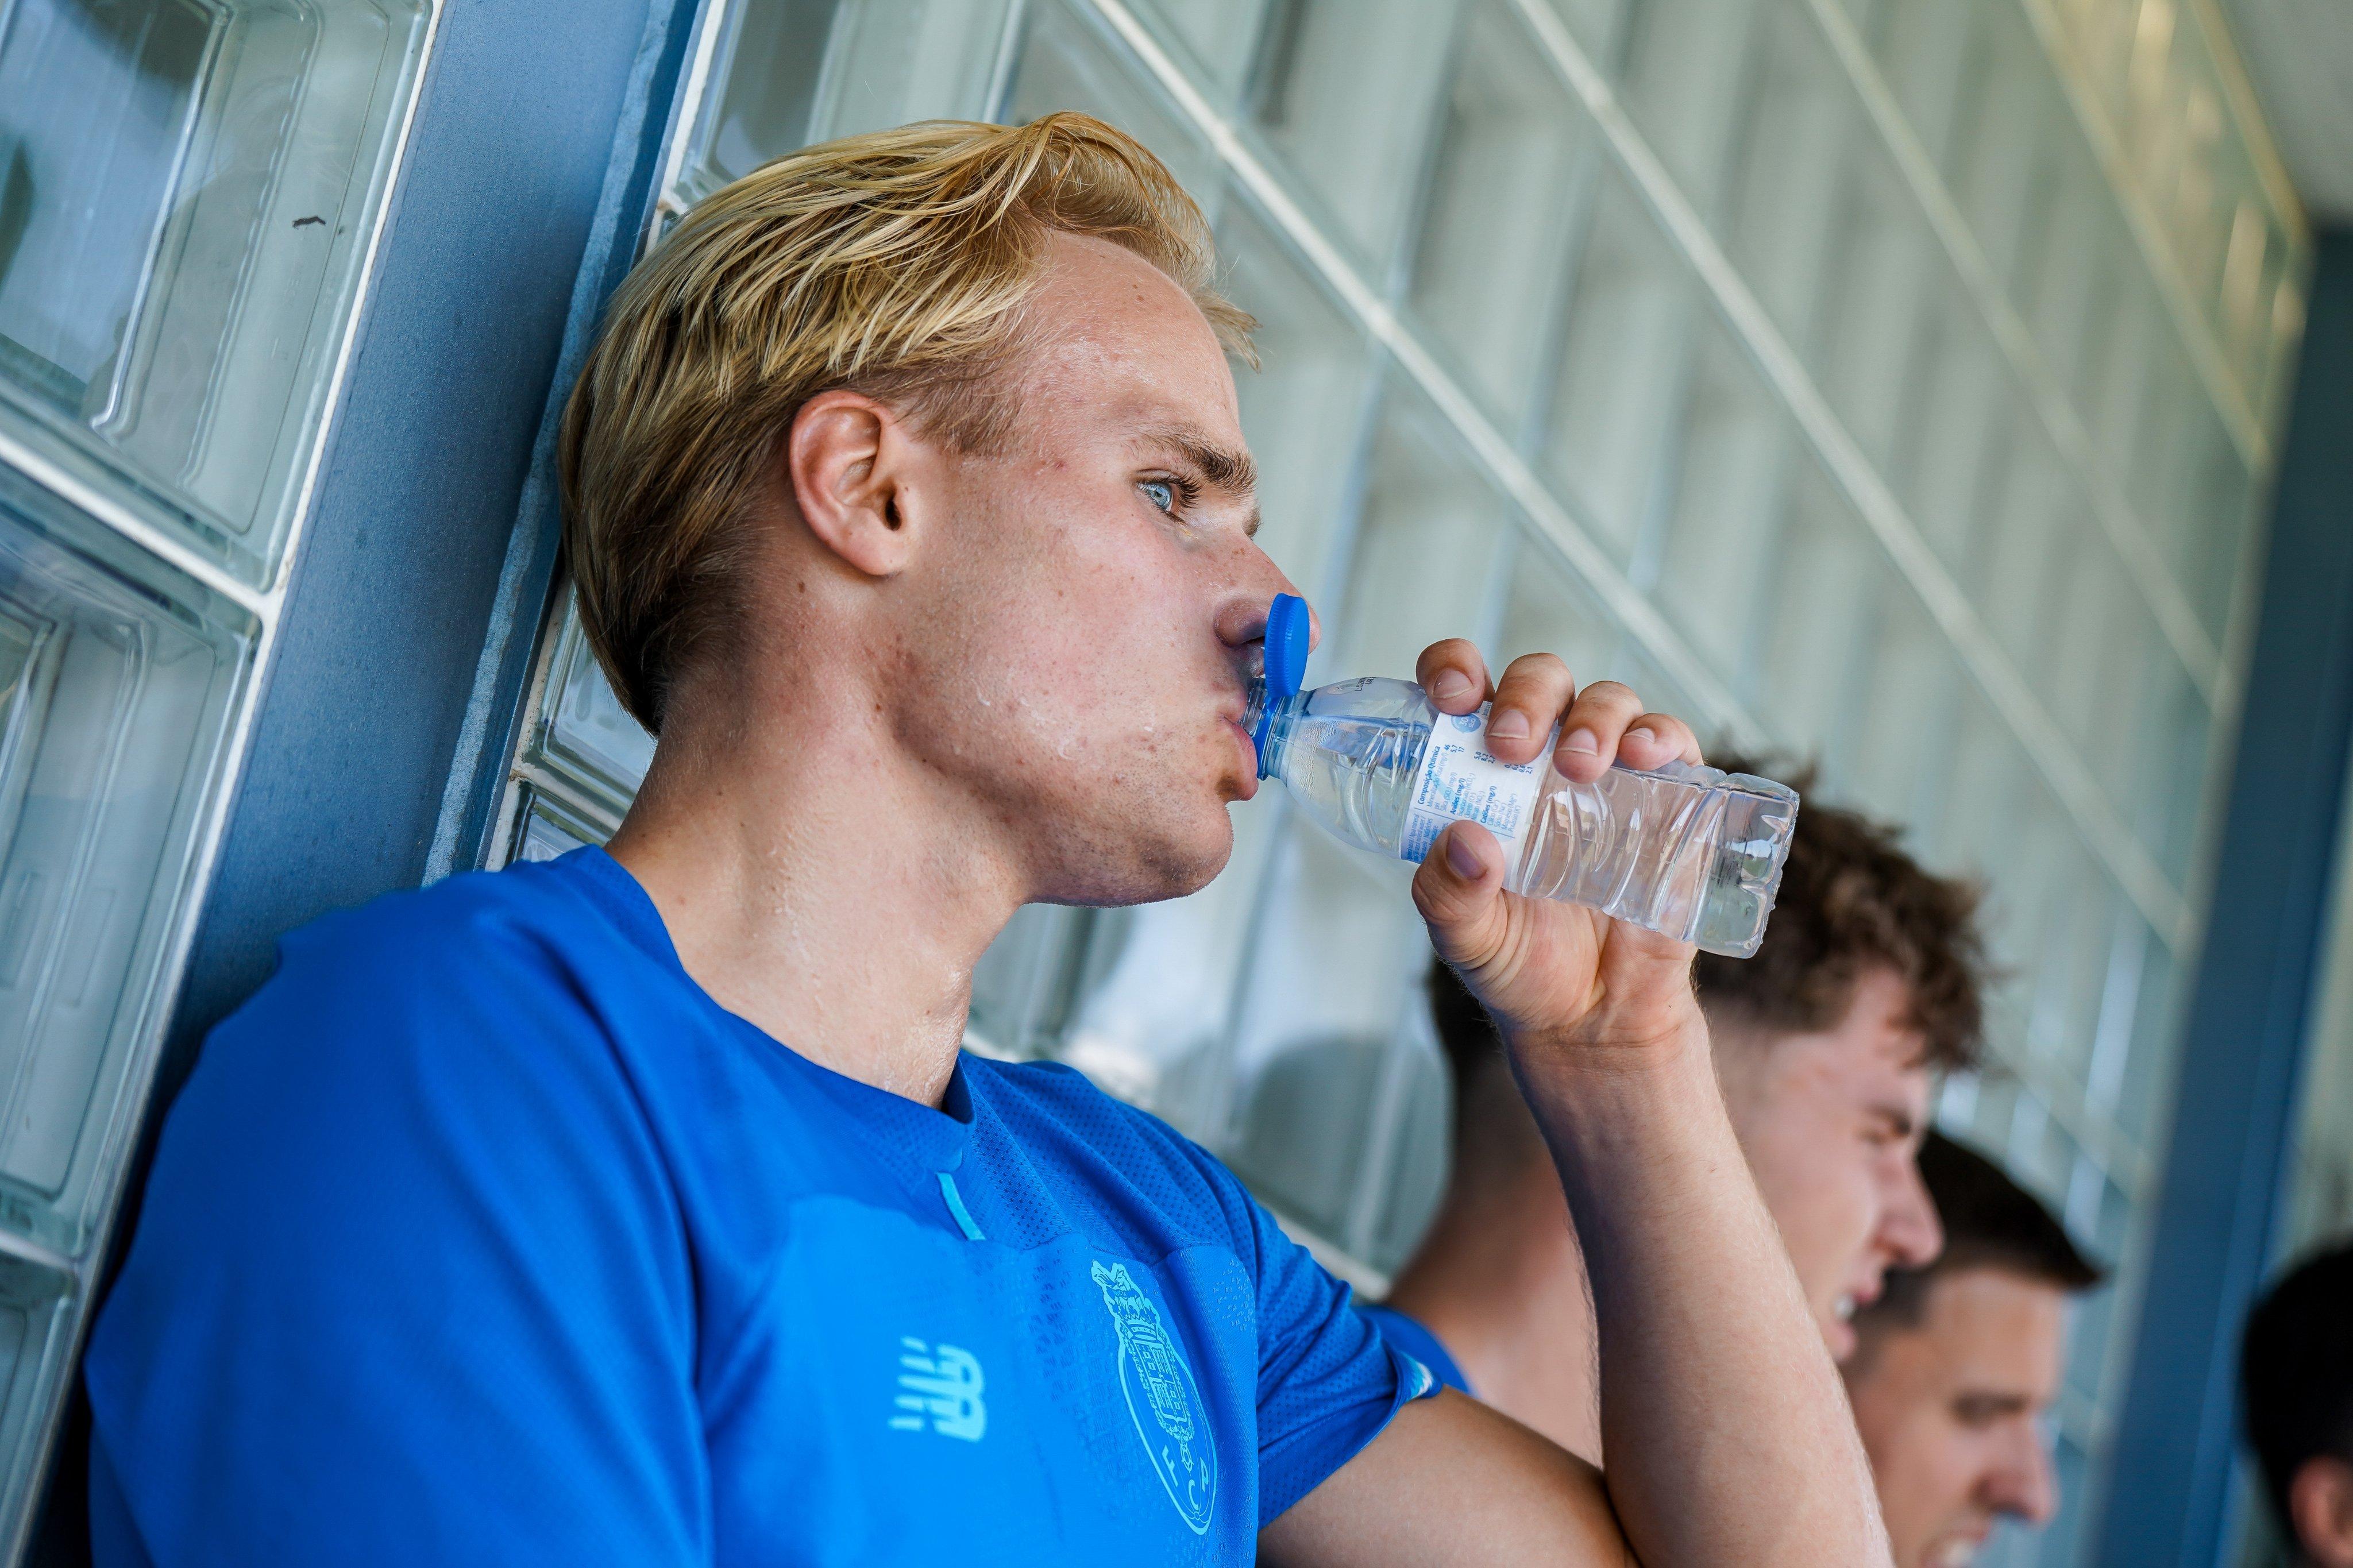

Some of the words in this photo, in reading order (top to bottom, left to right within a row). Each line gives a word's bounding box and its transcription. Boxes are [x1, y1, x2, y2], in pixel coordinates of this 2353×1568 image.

[1438, 752, 1448, 767] (mg/l)
[1473, 751, 1483, 760] 5,0
[1480, 753, 1488, 762] 8,2
[1416, 769, 1436, 805] Composição
[1427, 745, 1441, 770] Química
[1434, 802, 1442, 810] pH
[1451, 744, 1459, 753] 5,7
[1525, 766, 1533, 774] 2,1
[1446, 771, 1457, 787] (mg/l)
[1454, 777, 1466, 796] (mg/l)
[1449, 796, 1460, 814] Aniões
[1479, 804, 1491, 823] Catiões
[1485, 785, 1497, 804] (mg/l)
